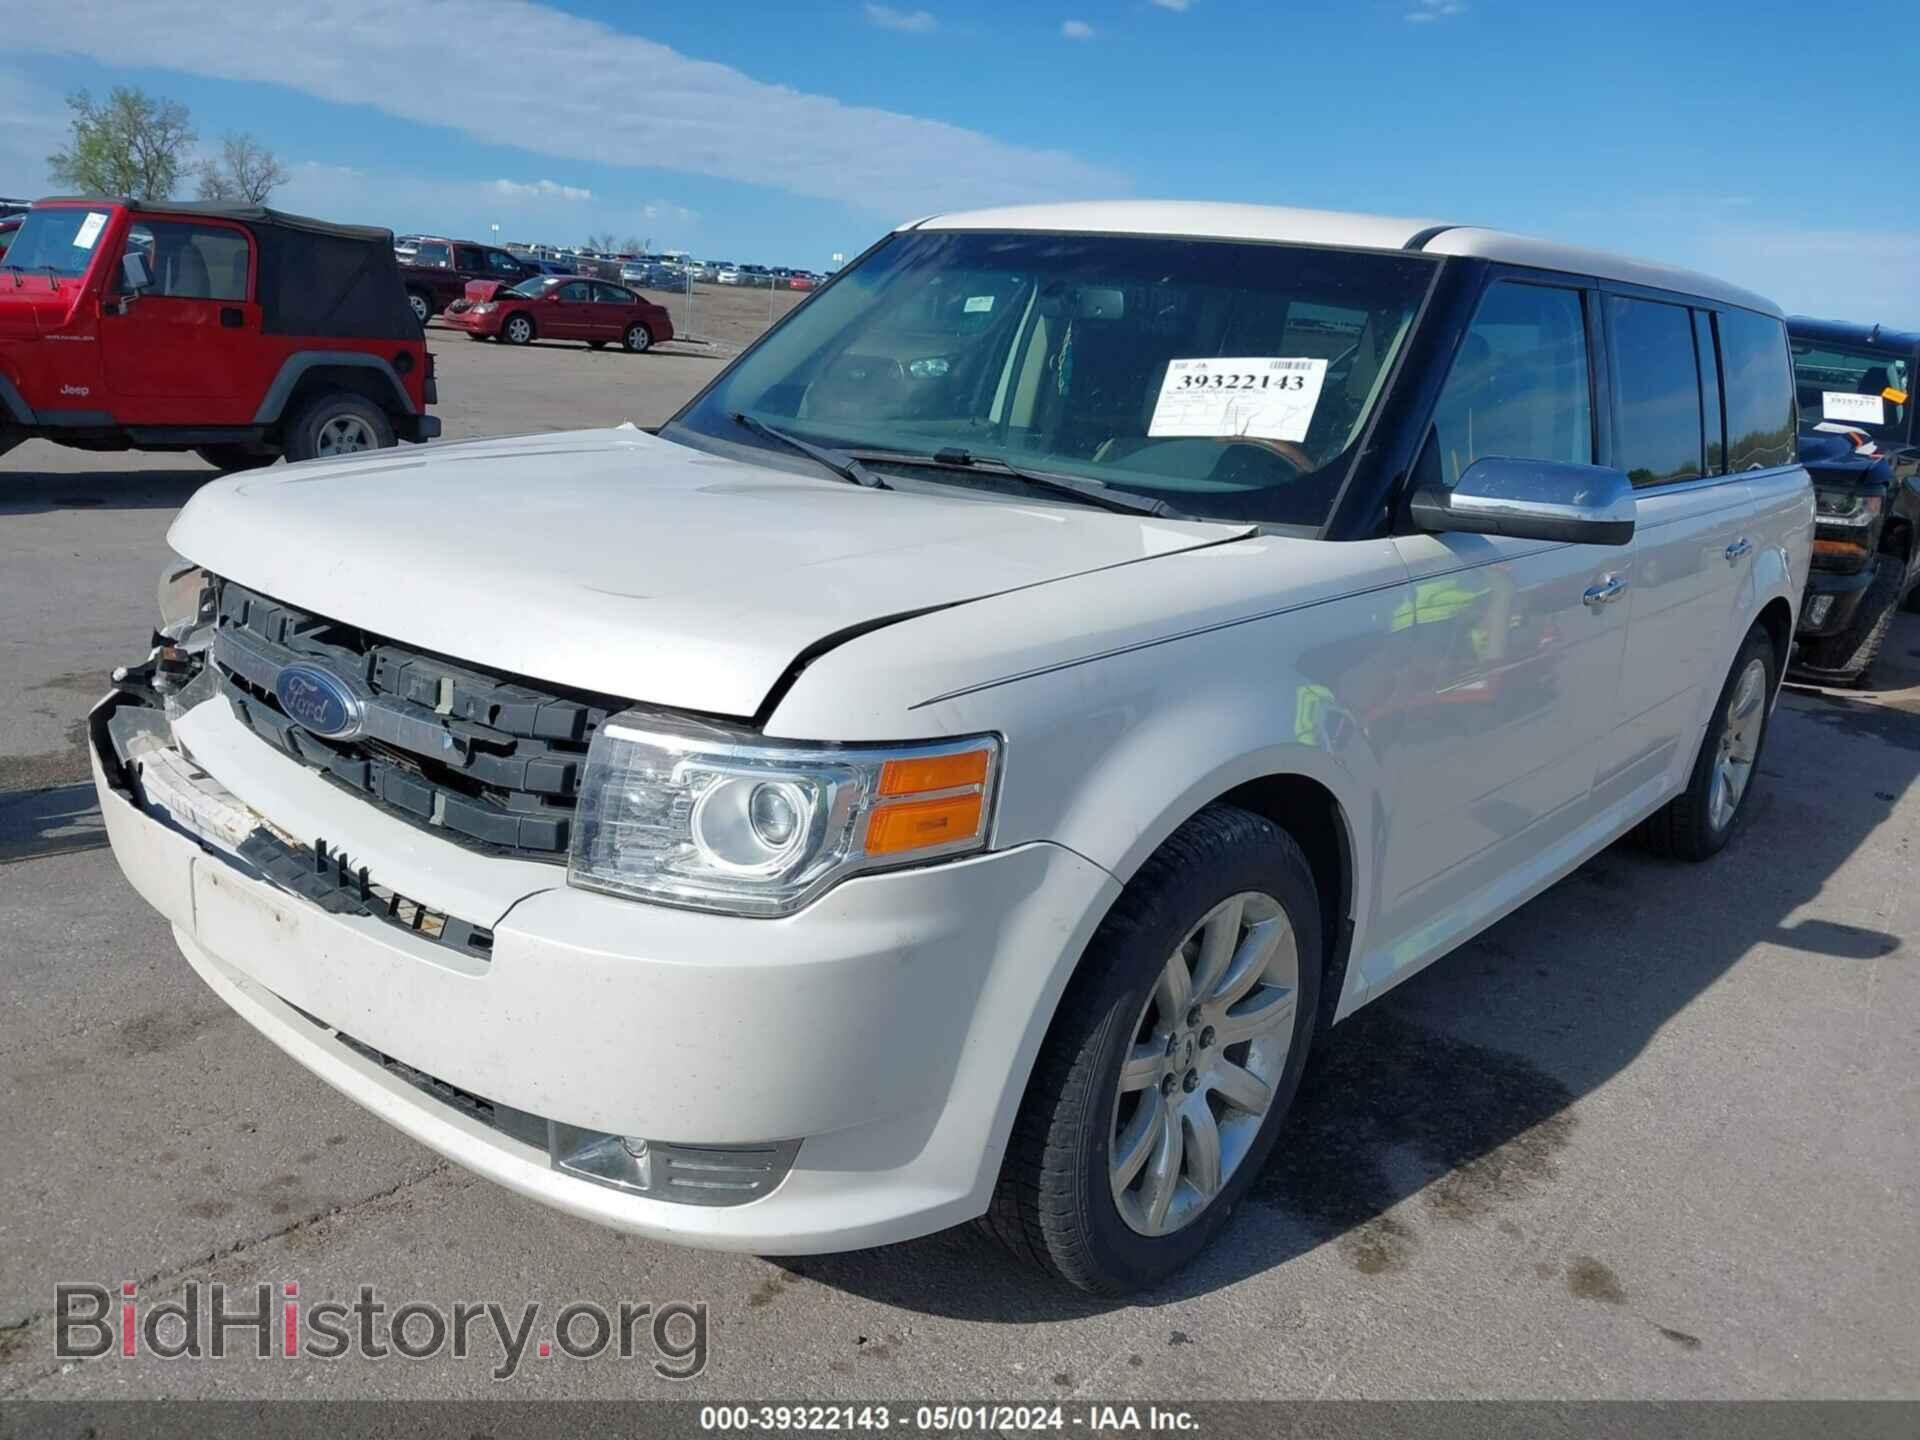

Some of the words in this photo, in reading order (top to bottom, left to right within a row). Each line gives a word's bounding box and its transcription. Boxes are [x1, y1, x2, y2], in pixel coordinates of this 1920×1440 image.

[60, 384, 89, 396] Jeep
[1176, 374, 1304, 391] 39322143
[285, 676, 328, 722] Ford
